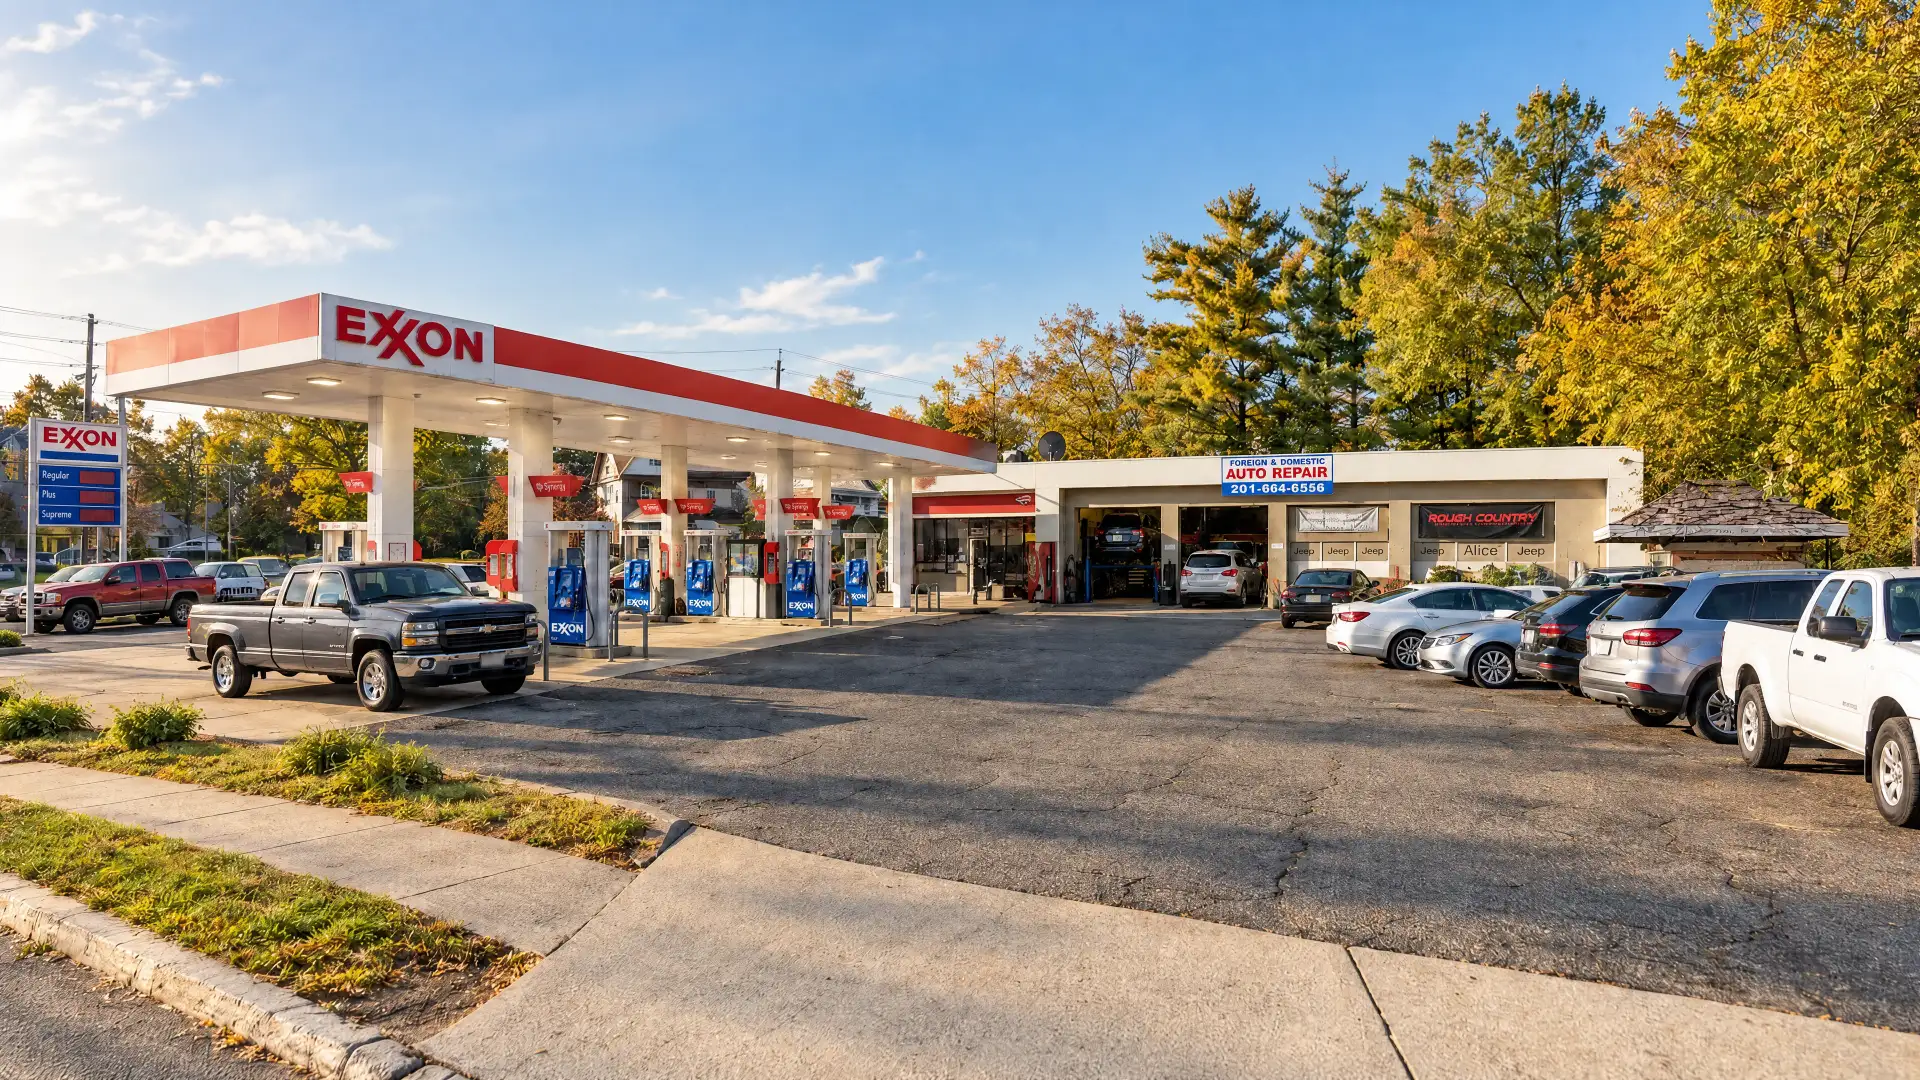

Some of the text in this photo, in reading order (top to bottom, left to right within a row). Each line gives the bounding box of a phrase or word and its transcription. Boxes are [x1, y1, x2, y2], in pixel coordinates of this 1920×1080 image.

[336, 305, 483, 367] EXXON
[44, 427, 117, 451] EXXON
[42, 470, 69, 481] Regular
[1226, 467, 1328, 479] AUTO REPAIR
[543, 483, 566, 491] Synergy
[1231, 483, 1325, 494] 201-664-6556
[42, 490, 56, 499] Plus
[42, 510, 72, 519] Supreme
[1428, 512, 1538, 523] ROUGH COUNTRY
[1294, 547, 1315, 556] Jeep
[1328, 547, 1349, 556] Jeep
[1362, 547, 1384, 556] Jeep
[1420, 546, 1445, 556] Jeep
[1464, 545, 1498, 556] Alice
[1517, 546, 1545, 557] Jeep
[627, 599, 649, 607] EXXON
[689, 599, 711, 608] EXXON
[788, 601, 813, 611] EXXON
[551, 622, 584, 636] EXXON
